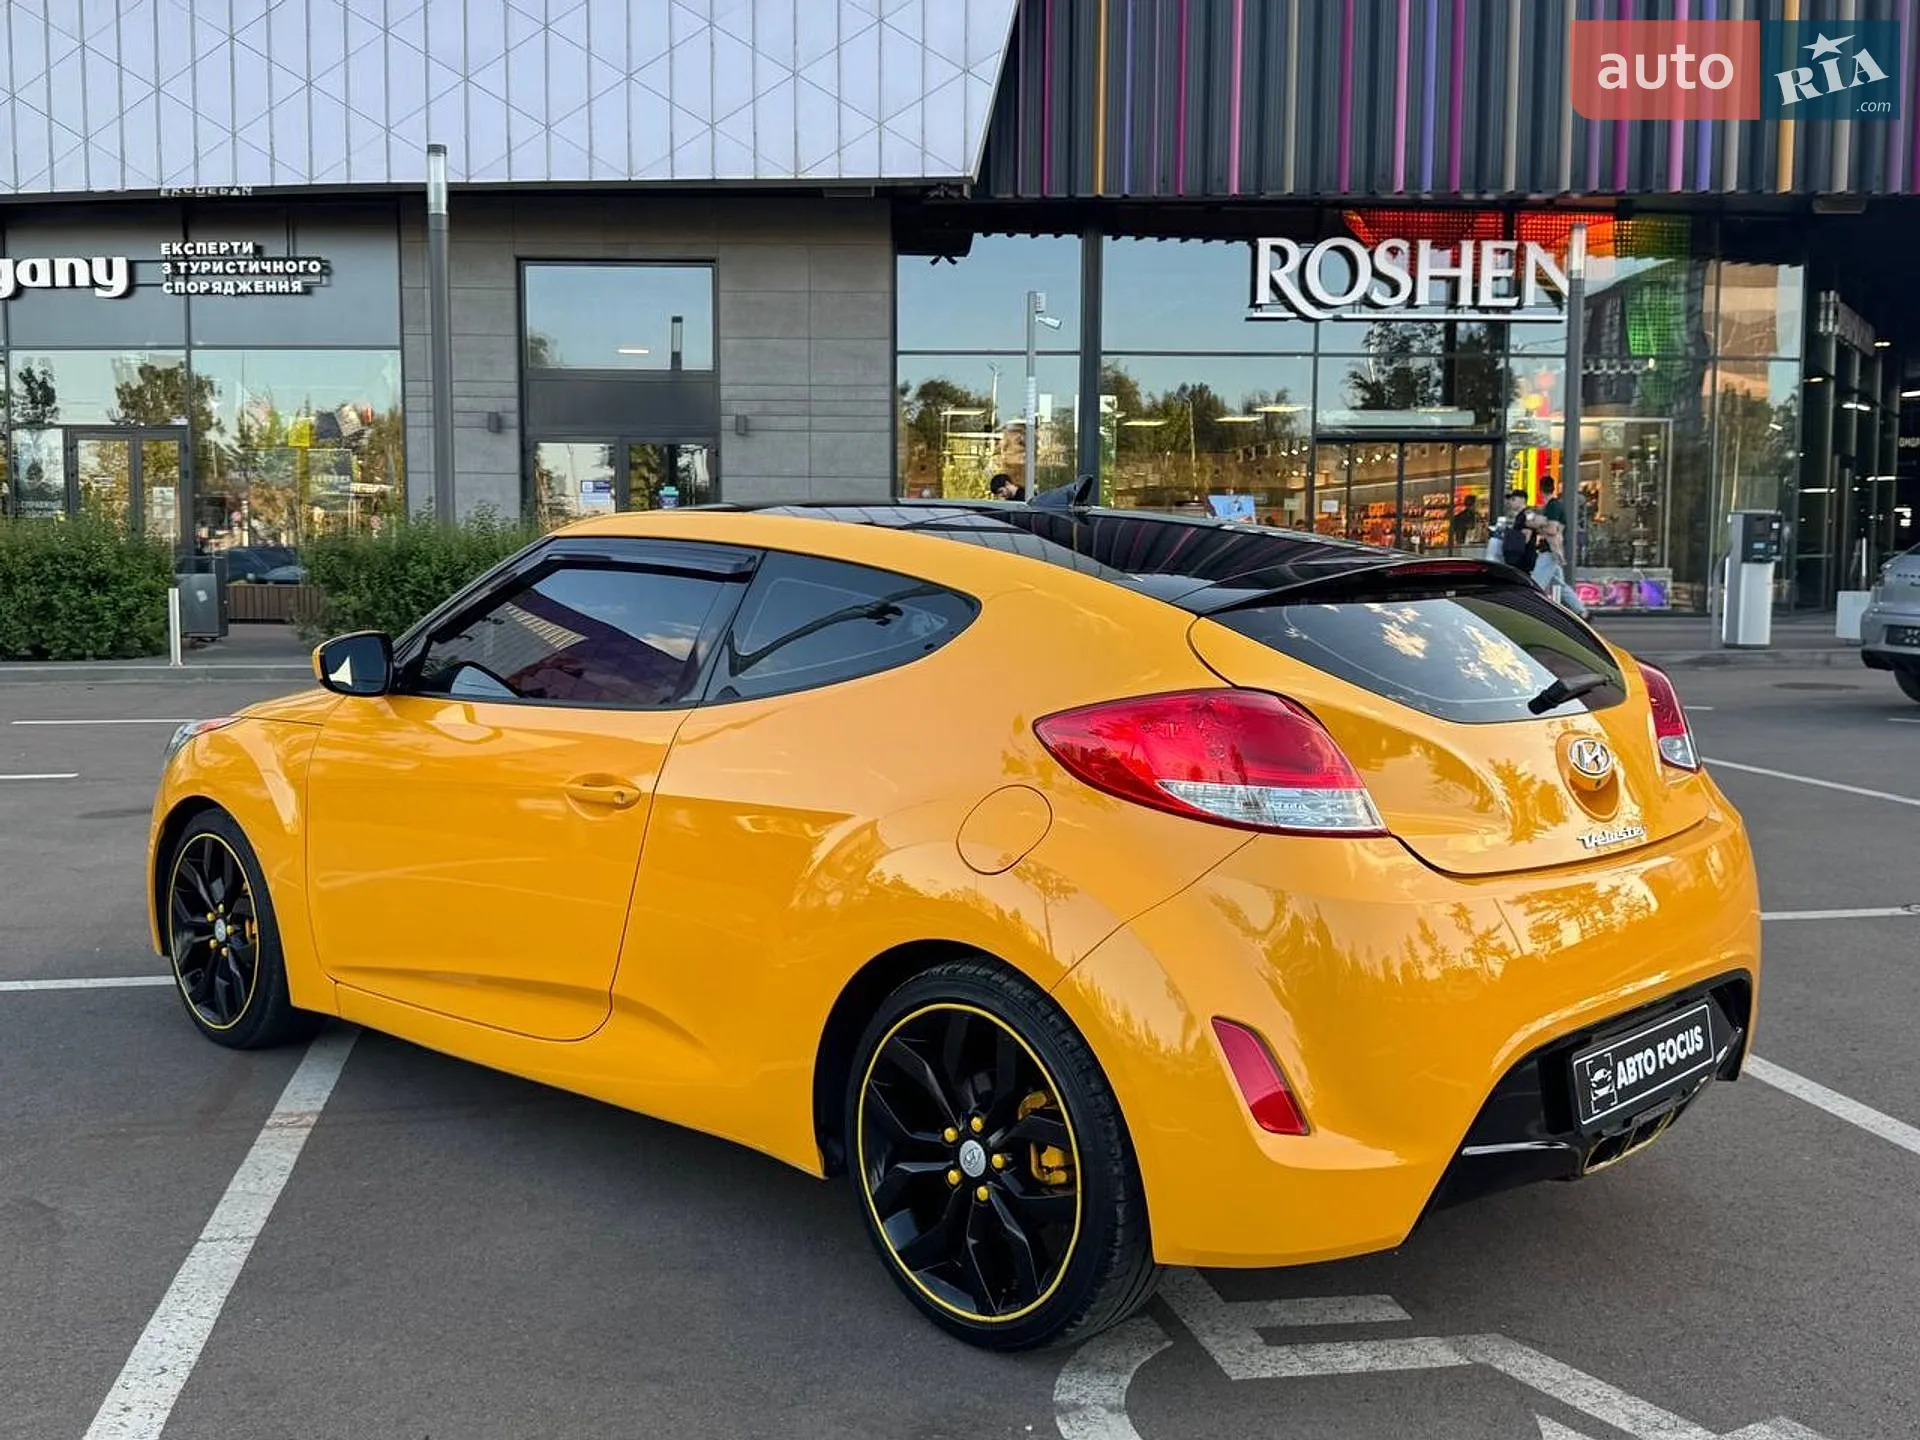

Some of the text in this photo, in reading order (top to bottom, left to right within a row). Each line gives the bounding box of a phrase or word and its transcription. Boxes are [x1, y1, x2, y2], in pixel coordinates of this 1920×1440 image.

[160, 242, 254, 255] ЕКСПЕРТИ
[177, 260, 322, 275] ТУРИСТИЧНОГО
[1255, 237, 1569, 319] ROSHEN
[162, 281, 303, 295] СПОРЯДЖЕННЯ
[1657, 1025, 1704, 1070] FOCUS
